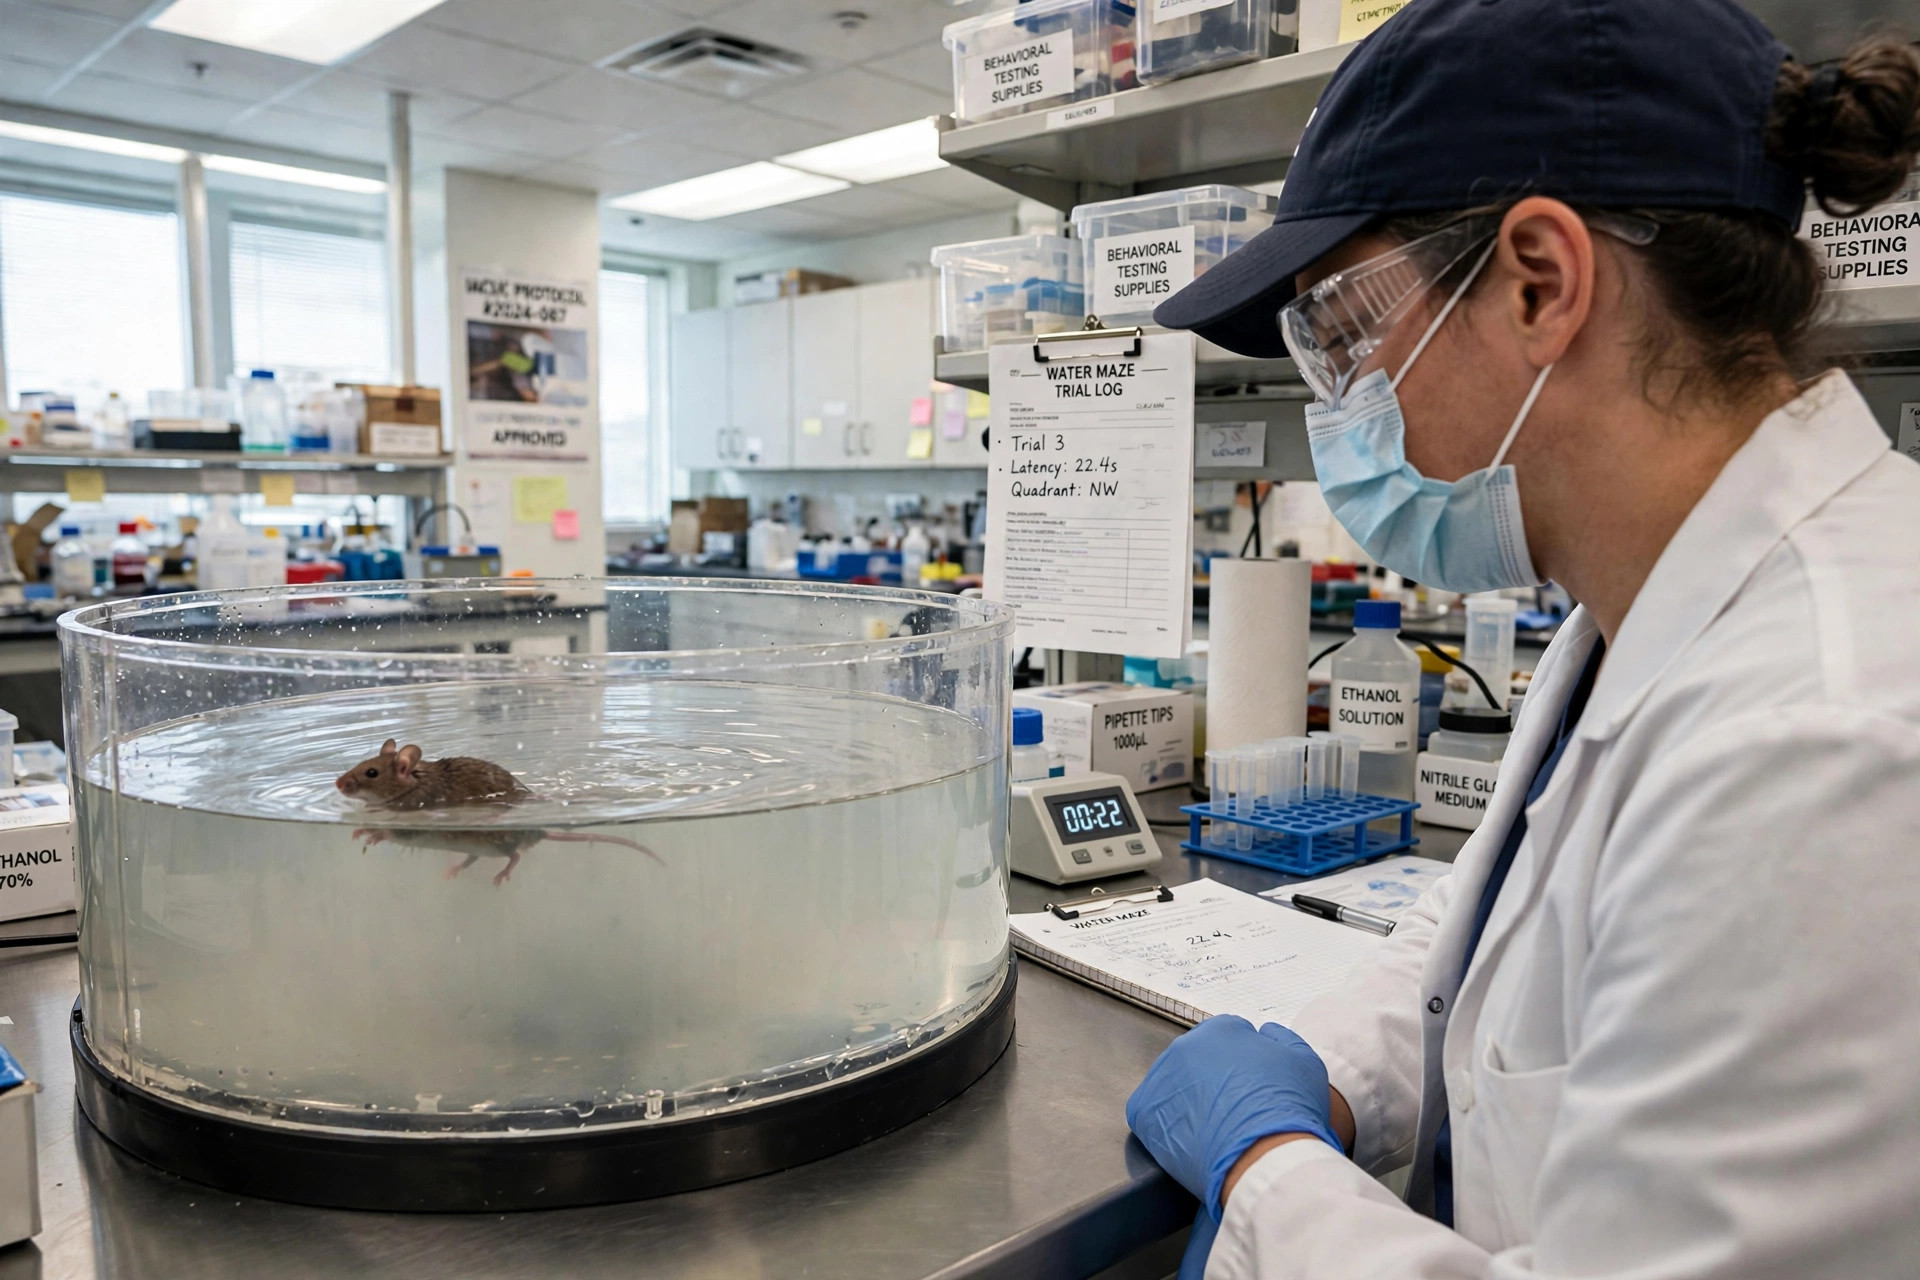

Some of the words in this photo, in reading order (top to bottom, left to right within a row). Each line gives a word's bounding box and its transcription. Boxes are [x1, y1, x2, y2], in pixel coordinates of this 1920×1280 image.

[984, 43, 1052, 71] BEHAVIORAL
[994, 64, 1039, 84] TESTING
[992, 81, 1043, 103] SUPPLIES
[1107, 240, 1182, 262] BEHAVIORAL
[1824, 236, 1907, 258] TESTING
[1117, 261, 1167, 278] TESTING
[1818, 259, 1908, 280] SUPPLIES
[1114, 280, 1170, 297] SUPPLIES
[1046, 366, 1092, 380] WATER
[1096, 363, 1135, 378] MAZE
[1055, 384, 1091, 398] TRIAL
[1095, 383, 1123, 396] LOG
[1011, 434, 1046, 451] Trial
[1055, 434, 1065, 451] 3
[1011, 459, 1067, 479] Latency:
[1075, 457, 1117, 473] 22.4s
[1011, 481, 1082, 498] Quadrant:
[1089, 481, 1119, 497] NW
[1341, 687, 1402, 703] ETHANOL
[1105, 709, 1148, 730] PIPETTE
[1151, 706, 1173, 723] TIPS
[1339, 709, 1404, 725] SOLUTION
[1420, 770, 1469, 789] NITRILE
[1435, 791, 1486, 810] MEDIUM
[1063, 799, 1123, 833] 00:22
[0, 849, 62, 869] HANOL
[0, 872, 33, 889] 70%
